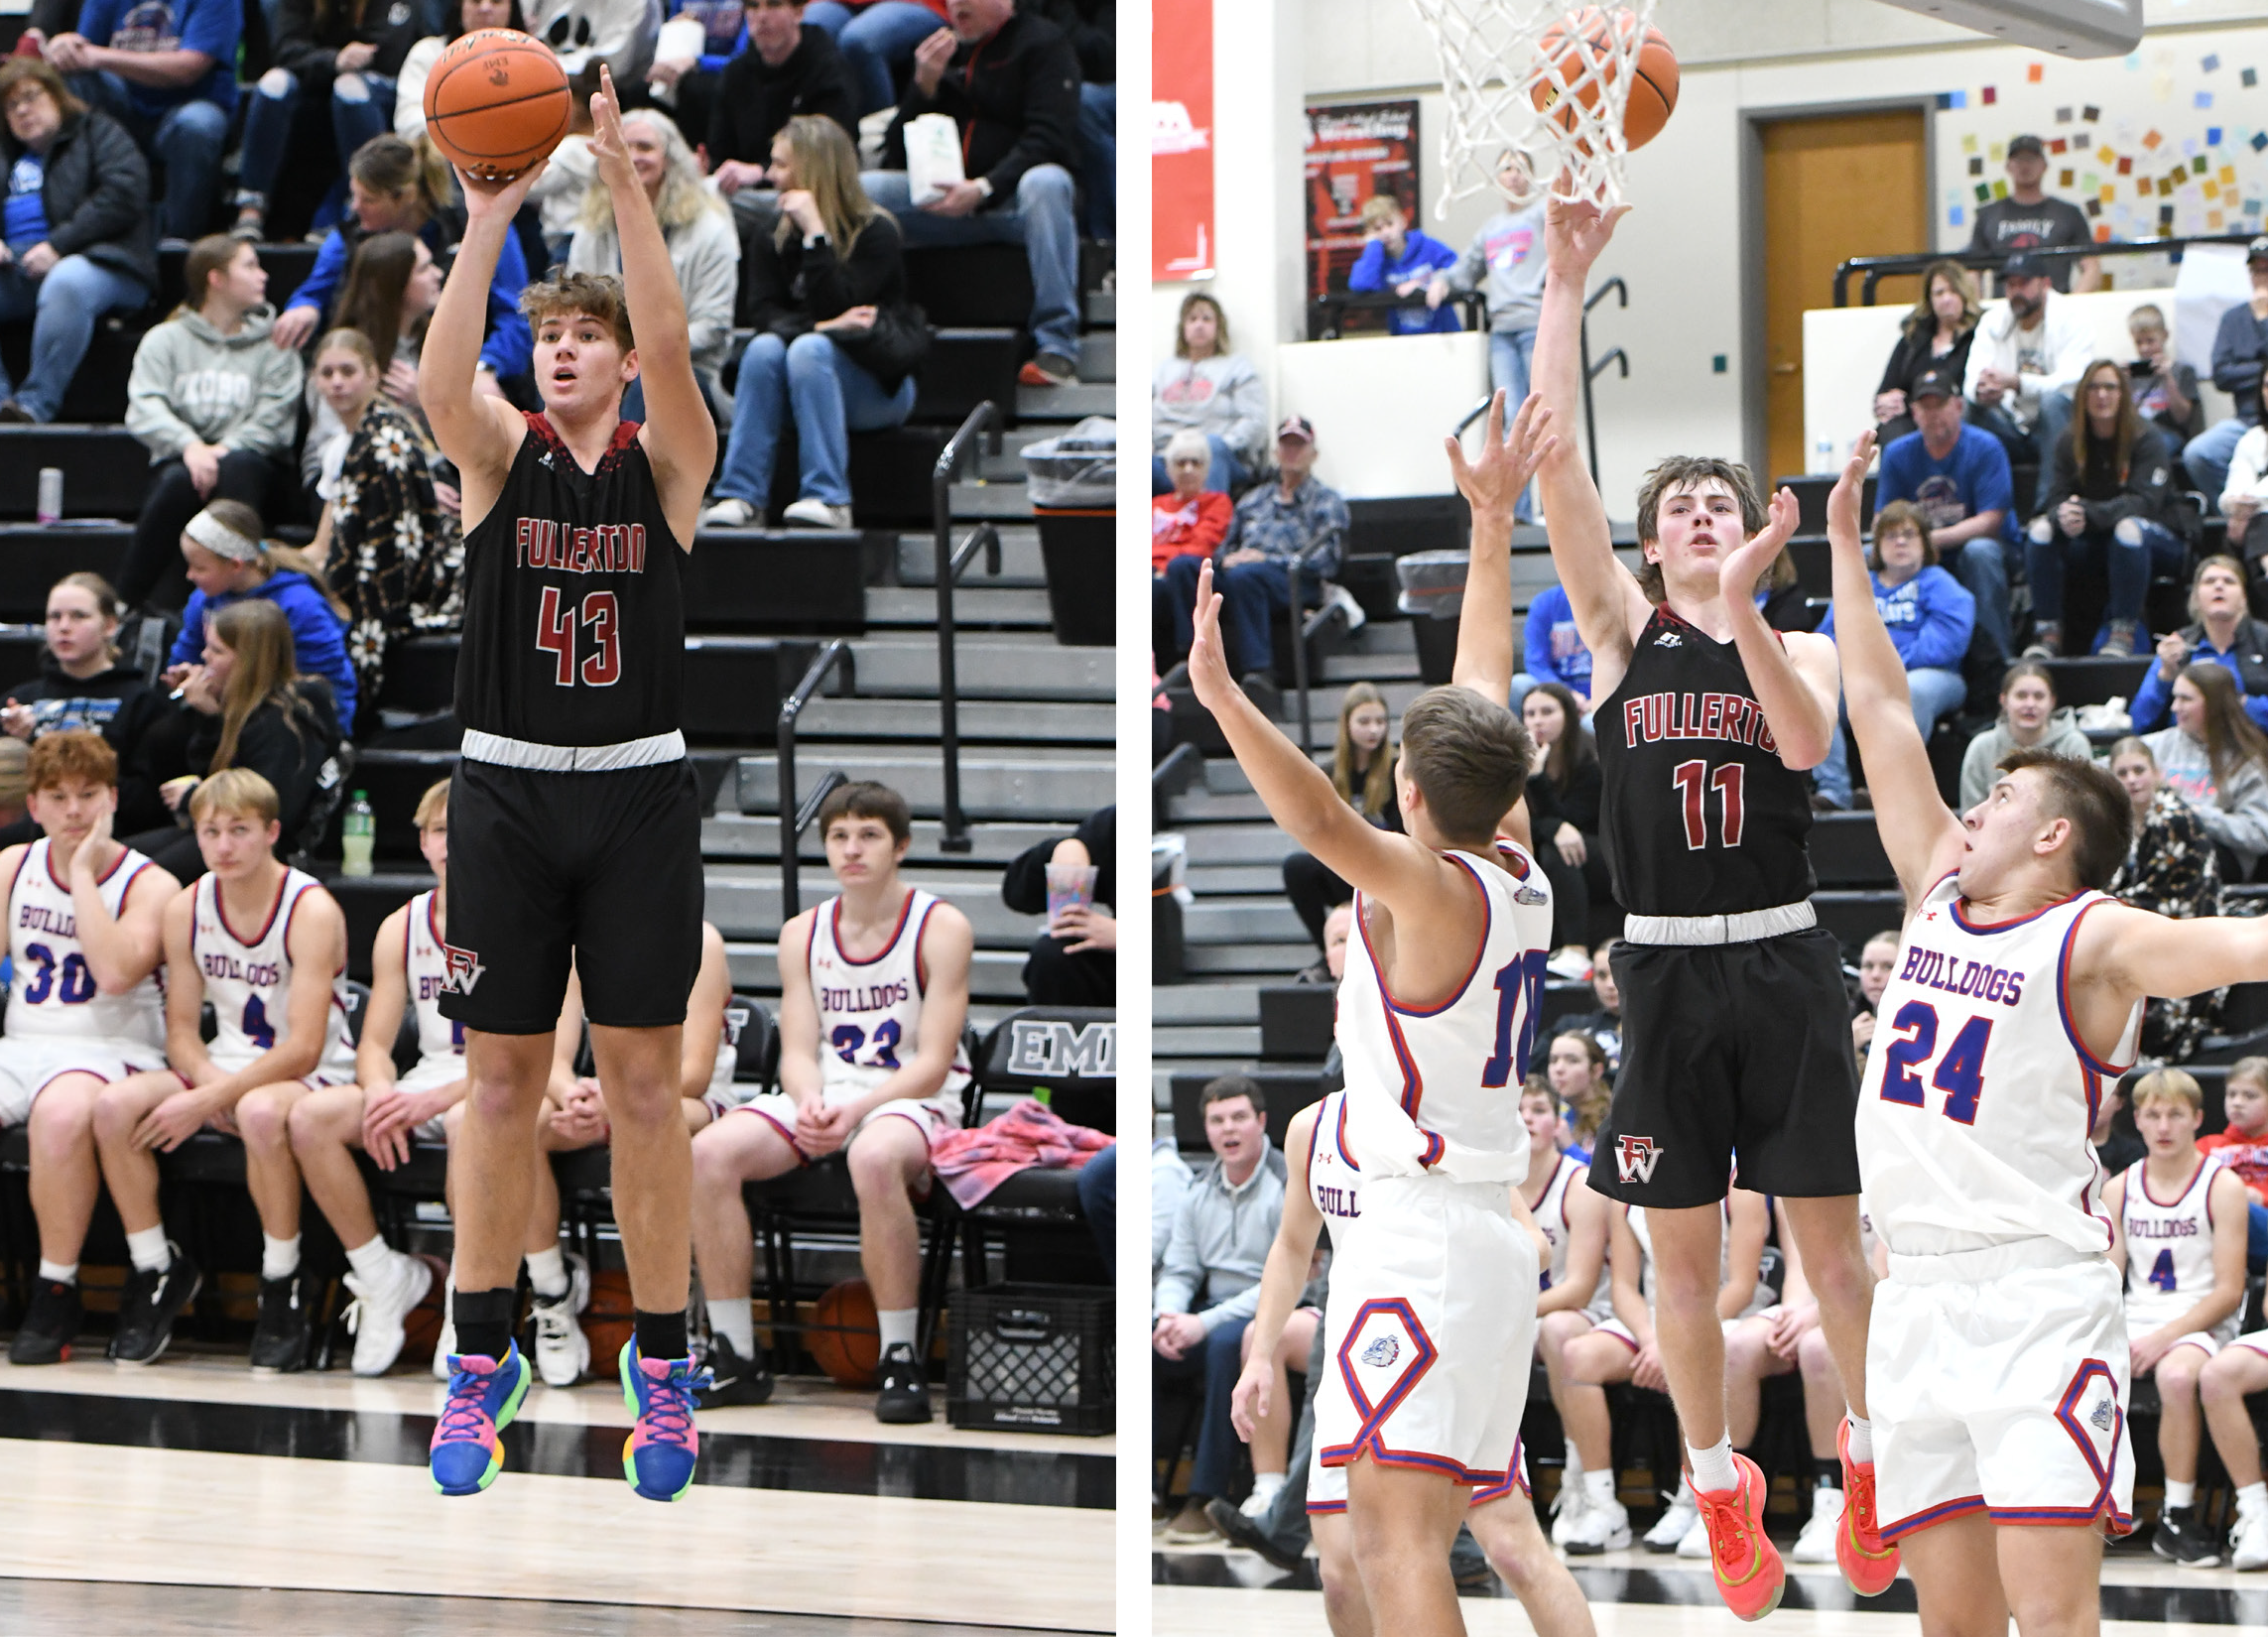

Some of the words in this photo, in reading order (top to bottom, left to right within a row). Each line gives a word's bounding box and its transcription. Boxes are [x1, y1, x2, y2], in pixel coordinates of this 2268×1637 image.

[516, 517, 646, 574] FULLERTON
[536, 585, 621, 688] 43
[1623, 692, 1781, 757] FULLERTO
[1673, 759, 1744, 850] 11
[25, 943, 97, 1004] 30
[1899, 945, 2025, 1007] BULLDOGS
[242, 992, 275, 1050] 4
[1879, 999, 1994, 1126] 24
[2148, 1249, 2177, 1292] 4
